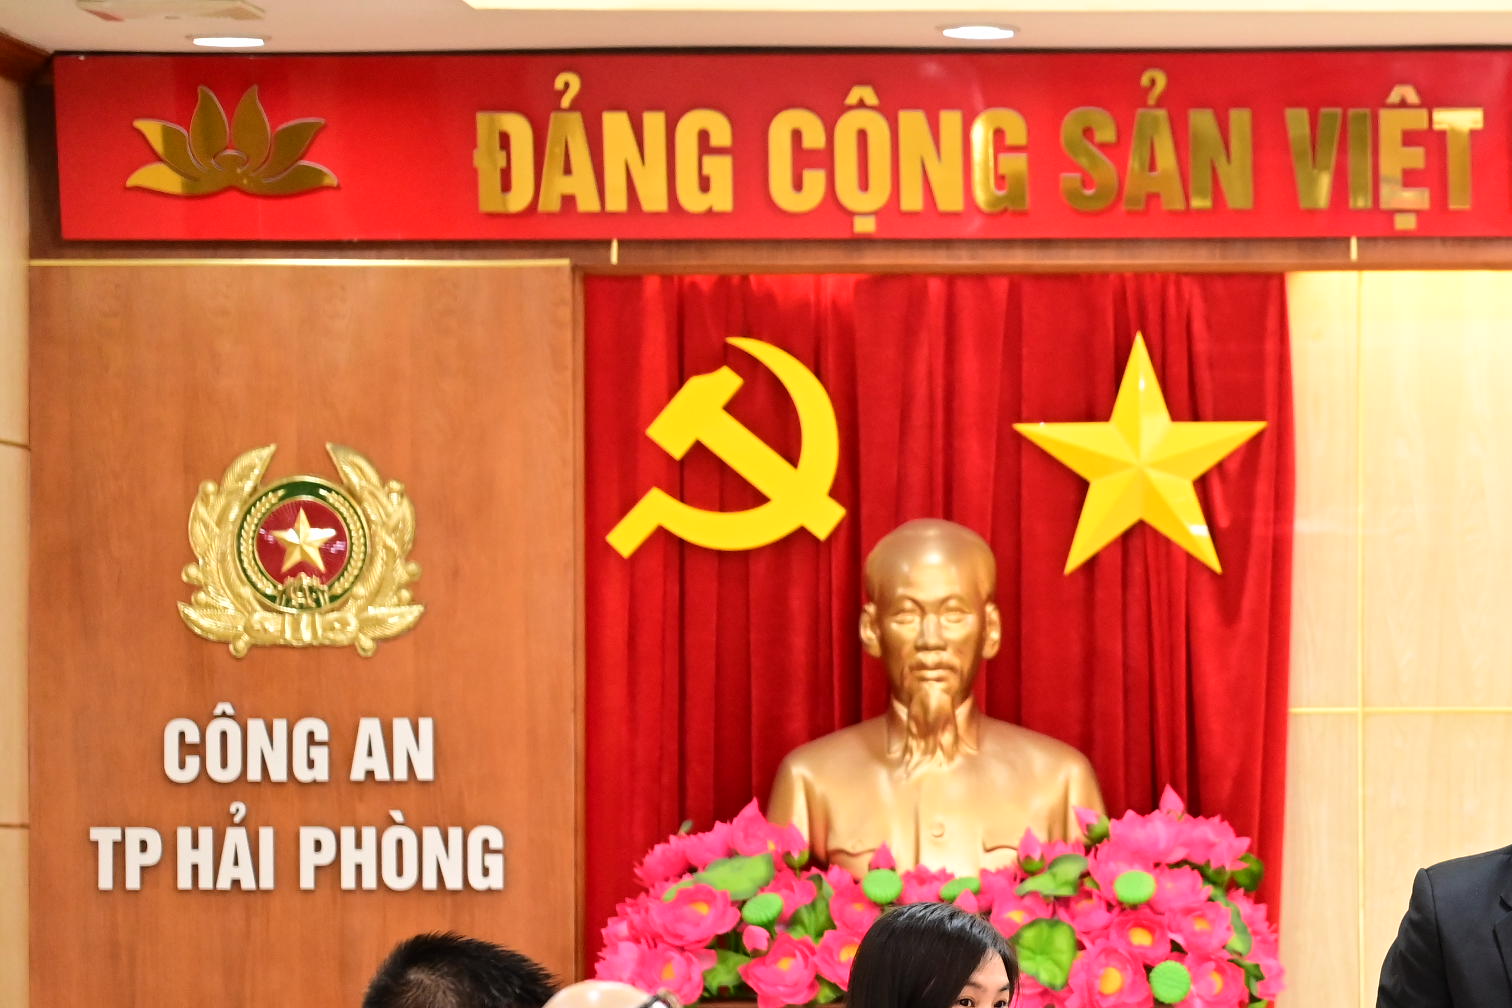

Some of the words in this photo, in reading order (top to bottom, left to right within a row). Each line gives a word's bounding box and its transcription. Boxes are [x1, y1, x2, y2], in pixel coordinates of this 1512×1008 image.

[473, 72, 734, 214] ĐẢNG
[768, 85, 1029, 233] CỘNG
[1059, 68, 1252, 213] SẢN
[1285, 83, 1484, 230] VIỆT
[163, 701, 331, 785] CÔNG
[349, 716, 435, 783] AN
[89, 825, 163, 891] TP
[176, 800, 275, 892] HẢI
[299, 809, 505, 892] PHÒNG
